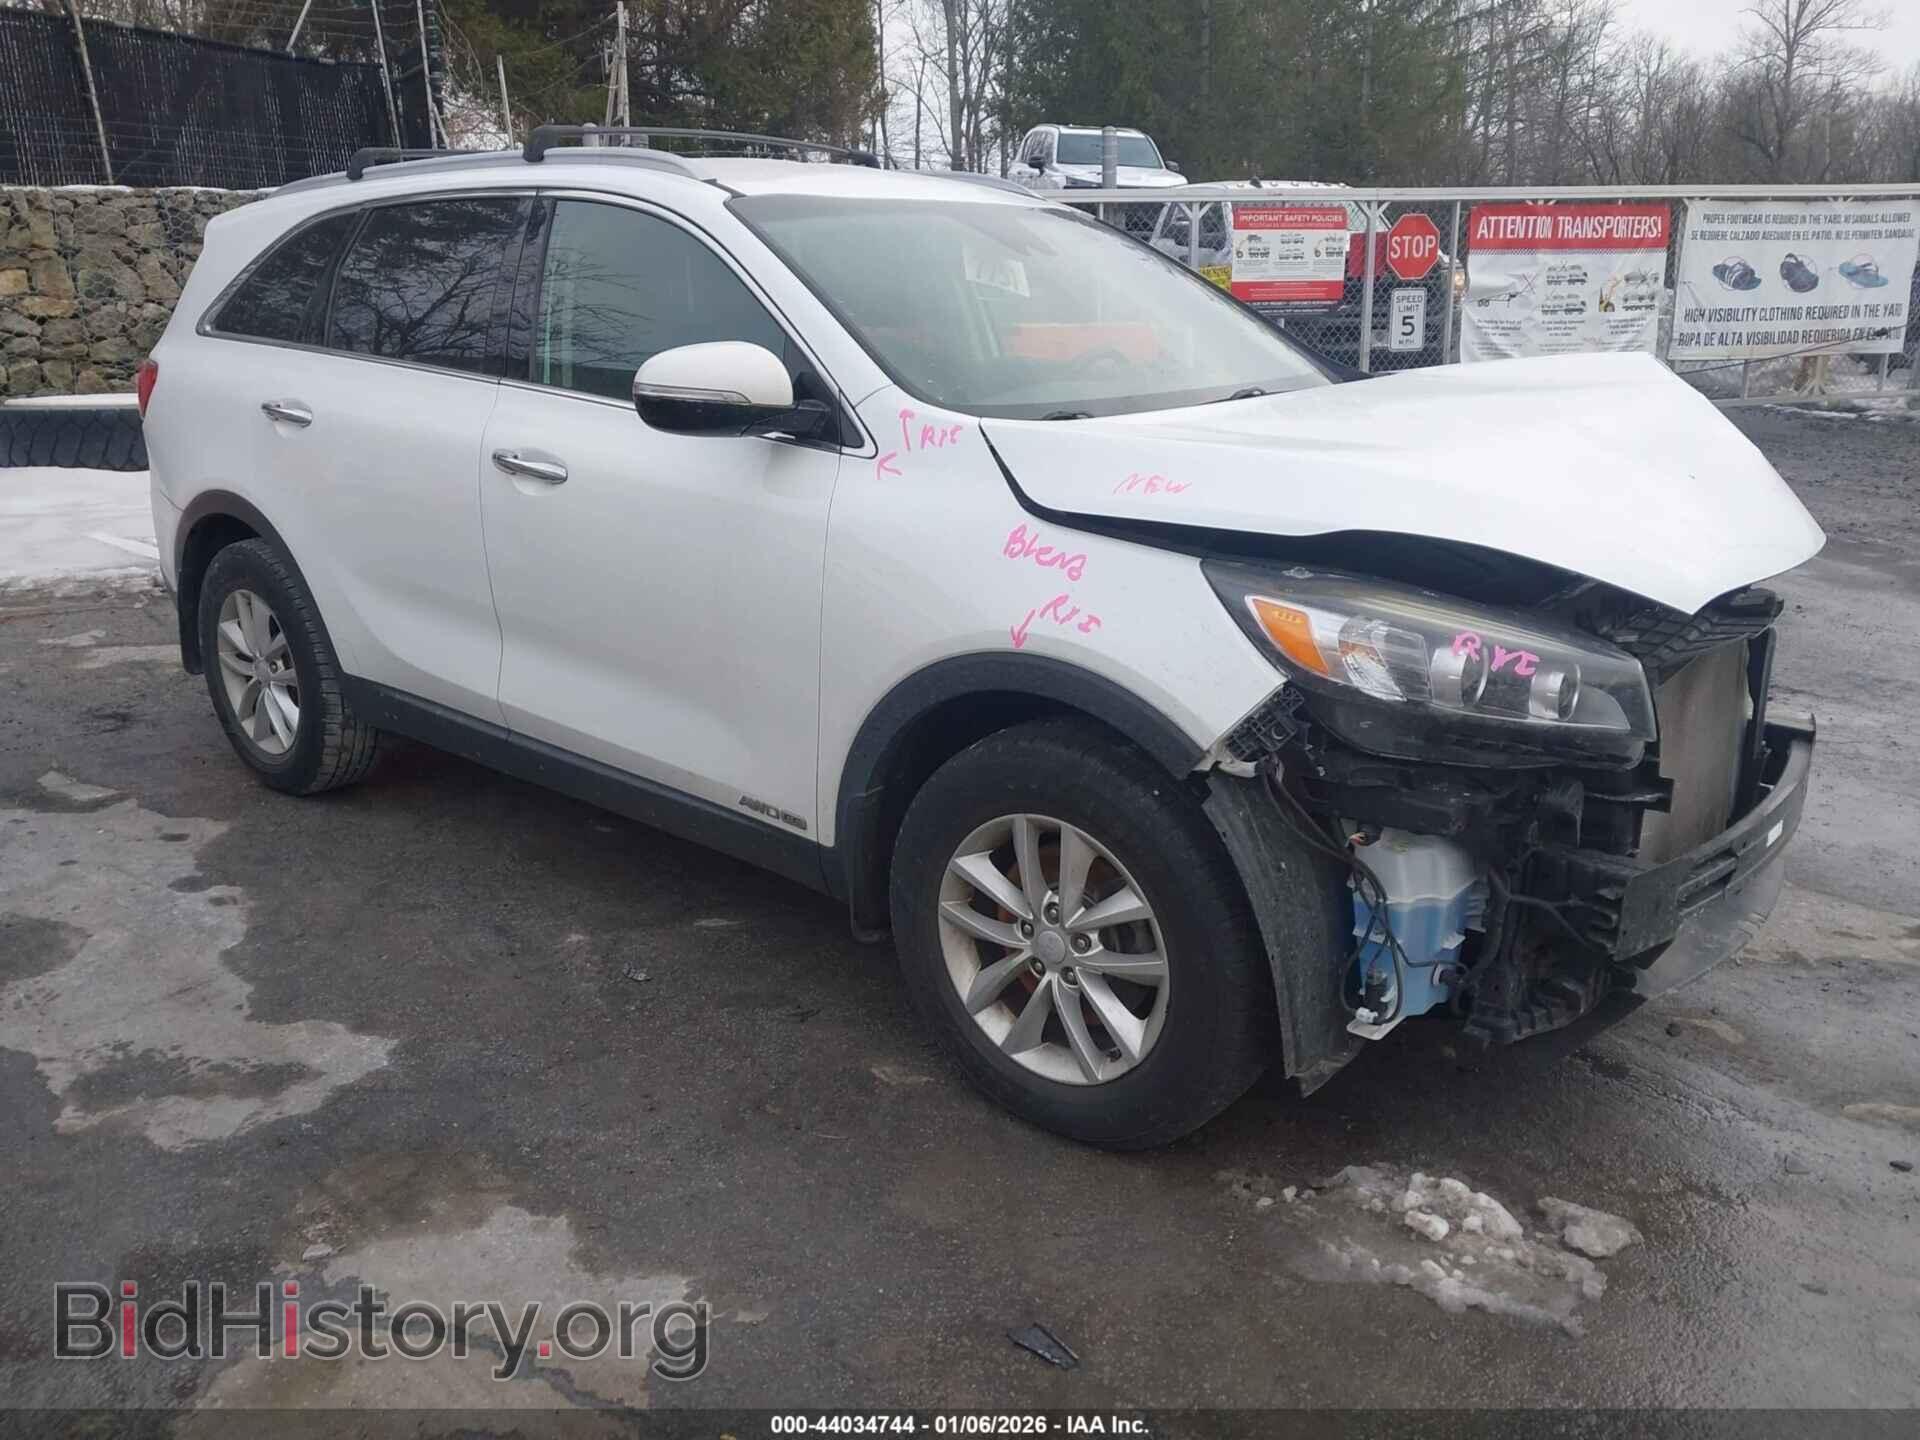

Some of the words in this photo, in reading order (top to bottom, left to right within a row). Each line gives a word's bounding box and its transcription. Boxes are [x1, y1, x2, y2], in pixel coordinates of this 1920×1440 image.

[1239, 214, 1282, 222] IMPORTANT
[1284, 214, 1310, 222] SAFETY
[1311, 213, 1343, 222] POLICIES
[1726, 213, 1763, 224] FOOTWEAR
[1809, 213, 1821, 224] THE
[1477, 216, 1553, 239] ATTENTION
[1557, 216, 1662, 239] TRANSPORTERS!
[1391, 235, 1436, 259] STOP
[1395, 295, 1423, 303] SPEED
[1398, 304, 1419, 312] LIMIT
[1683, 308, 1706, 322] HIGH
[1708, 307, 1758, 322] VISIBILITY
[1759, 306, 1804, 321] CLOTHING
[1806, 305, 1850, 320] REQUIRED
[1851, 304, 1861, 319] IN
[1864, 304, 1881, 318] THE
[1401, 315, 1416, 336] 5
[1703, 332, 1716, 346] DE
[1718, 331, 1743, 346] ALTA
[1746, 329, 1799, 346] VISIBILIDAD
[1801, 328, 1851, 344] REQUERIDA
